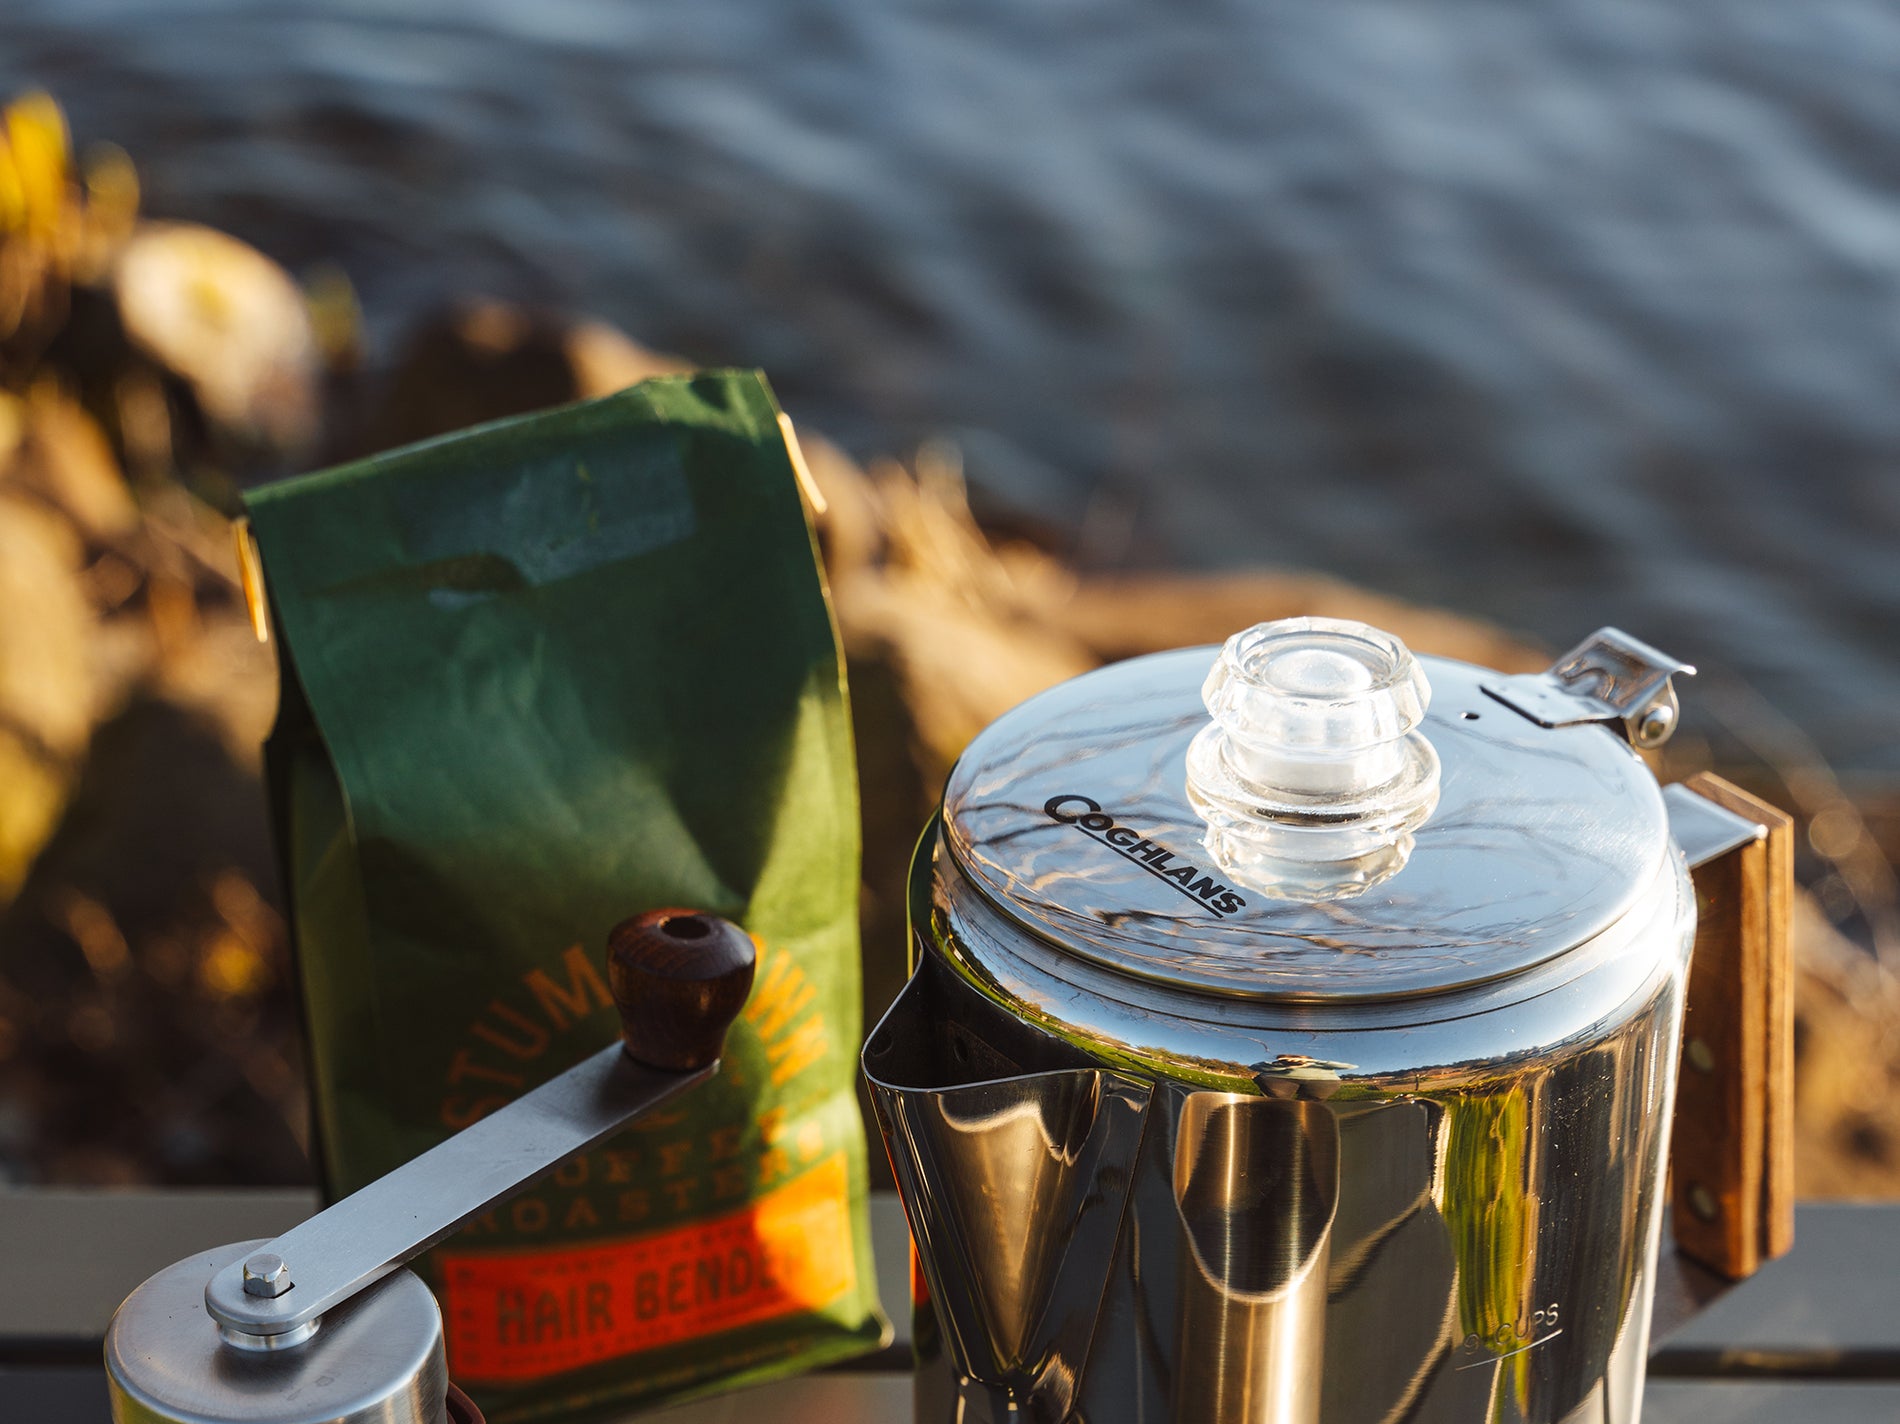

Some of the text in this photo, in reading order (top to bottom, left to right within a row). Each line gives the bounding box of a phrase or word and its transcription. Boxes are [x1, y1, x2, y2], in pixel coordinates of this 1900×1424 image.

[1044, 794, 1247, 914] COGHLAN'S
[440, 933, 829, 1129] STUMWN
[545, 1106, 790, 1188] OFFEE
[496, 1277, 614, 1346] HAIR
[633, 1246, 784, 1323] BEND
[1495, 1302, 1560, 1346] CUPS
